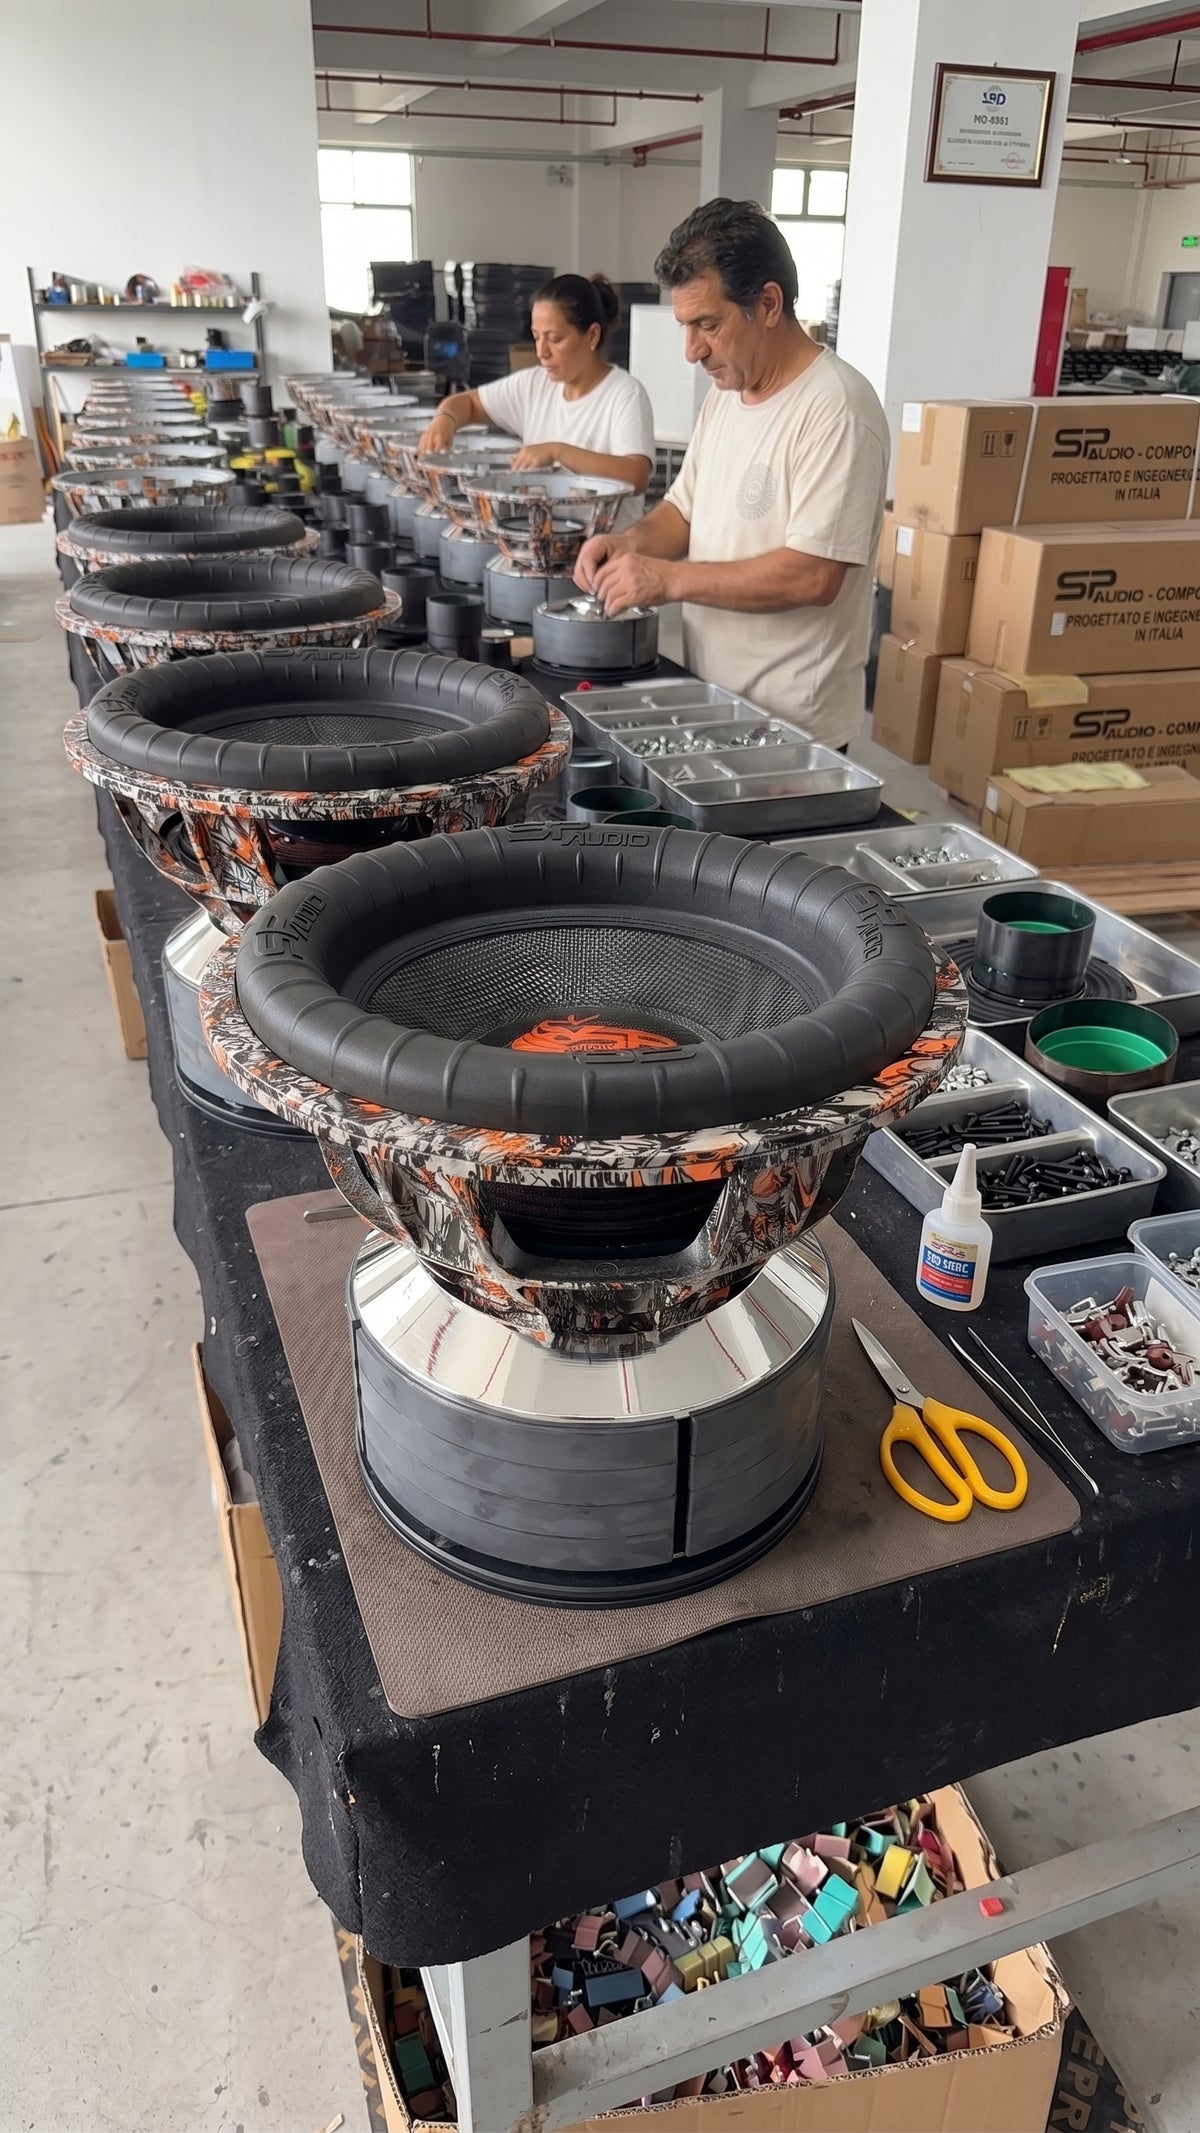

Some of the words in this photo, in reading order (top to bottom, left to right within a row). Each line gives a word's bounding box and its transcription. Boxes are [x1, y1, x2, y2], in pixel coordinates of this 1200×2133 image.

[1145, 445, 1196, 459] COMPO
[1050, 470, 1121, 484] PROGETTATO
[1124, 470, 1131, 482] E
[1114, 489, 1125, 500] IN
[1128, 487, 1160, 499] ITALIA
[1066, 612, 1140, 628] PROGETTATO
[1143, 611, 1151, 623] E
[1134, 629, 1145, 641] IN
[1148, 627, 1183, 640] ITALIA
[1147, 746, 1155, 758] E
